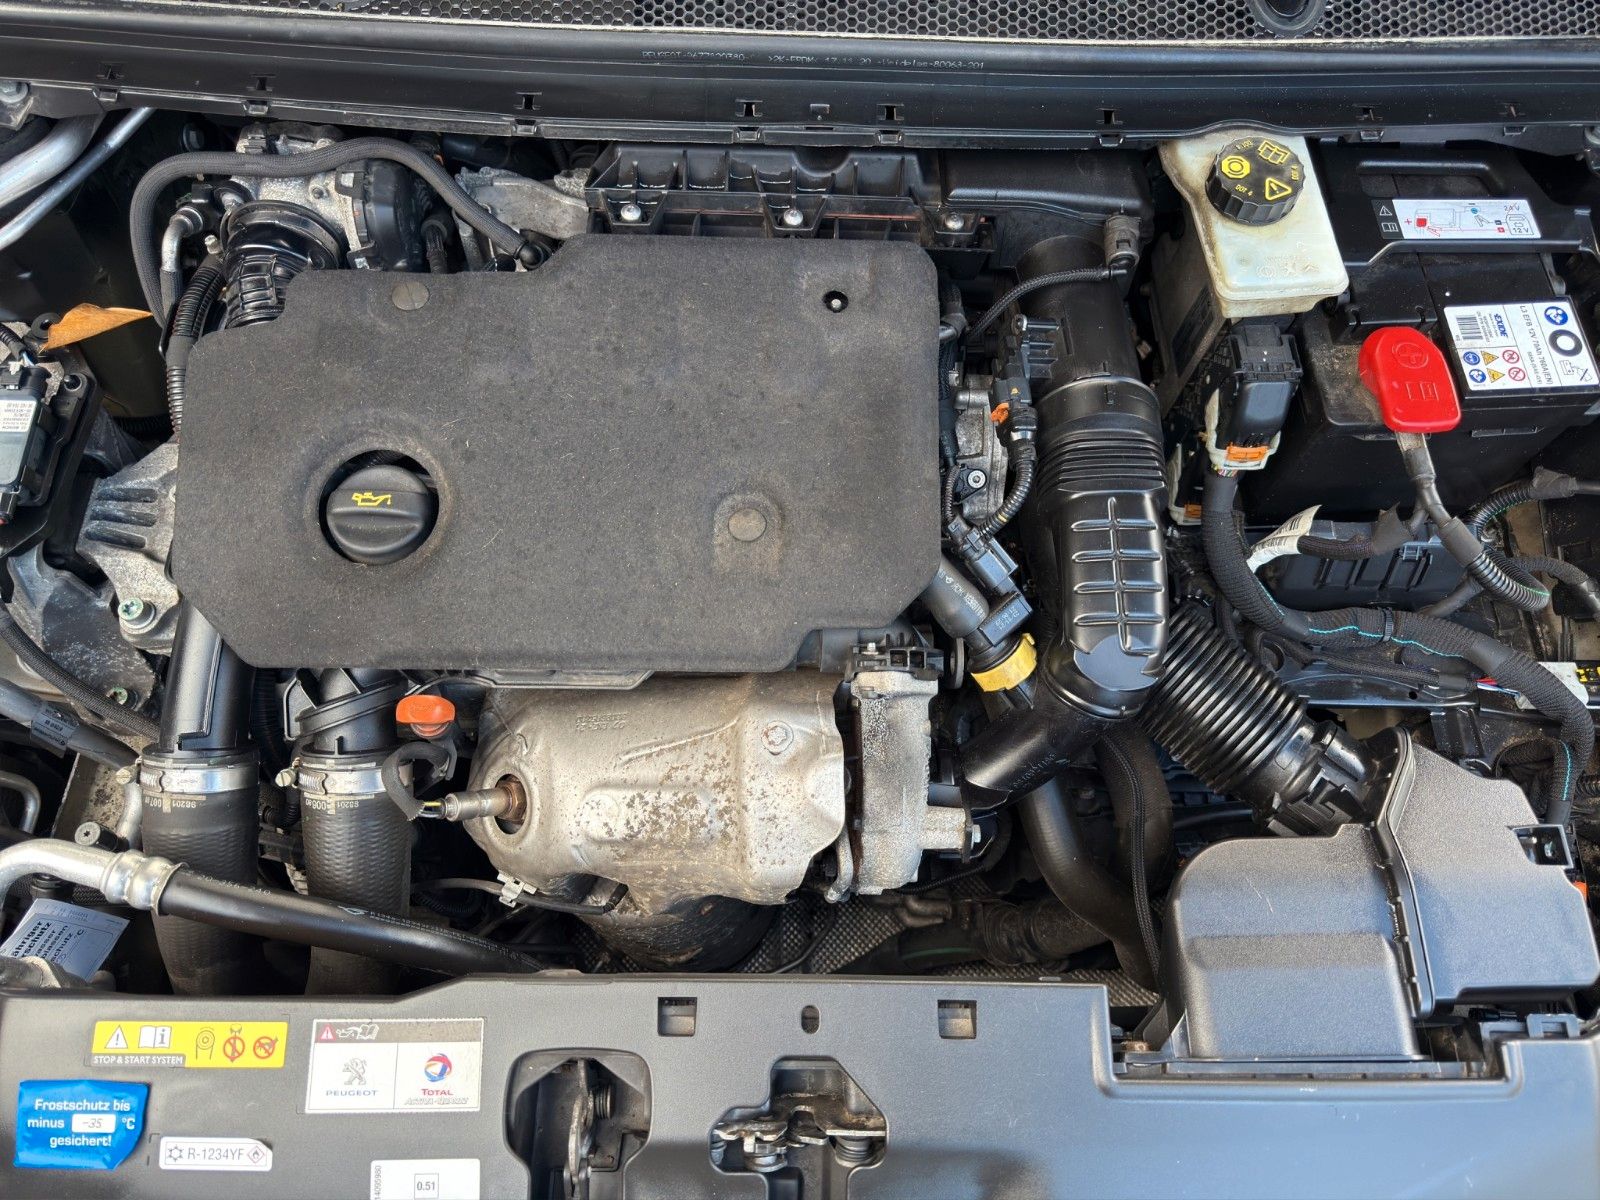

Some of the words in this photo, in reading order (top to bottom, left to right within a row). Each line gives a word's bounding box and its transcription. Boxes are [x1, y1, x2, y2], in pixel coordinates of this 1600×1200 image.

[1235, 184, 1248, 193] DOT
[1494, 313, 1508, 338] EXIDE
[1522, 314, 1533, 327] EFB
[11, 920, 42, 957] ähriger
[93, 1055, 117, 1064] STOP
[117, 1055, 123, 1064] &
[124, 1055, 150, 1064] START
[151, 1055, 184, 1064] SYSTEM
[421, 1088, 454, 1096] TOTAL
[34, 1099, 111, 1111] Frostschutz
[113, 1099, 131, 1111] bis
[27, 1117, 65, 1129] minus
[121, 1117, 136, 1130] °C
[49, 1136, 112, 1149] gesichert!
[187, 1148, 245, 1161] R-1234YF
[416, 1181, 436, 1191] 0.51
